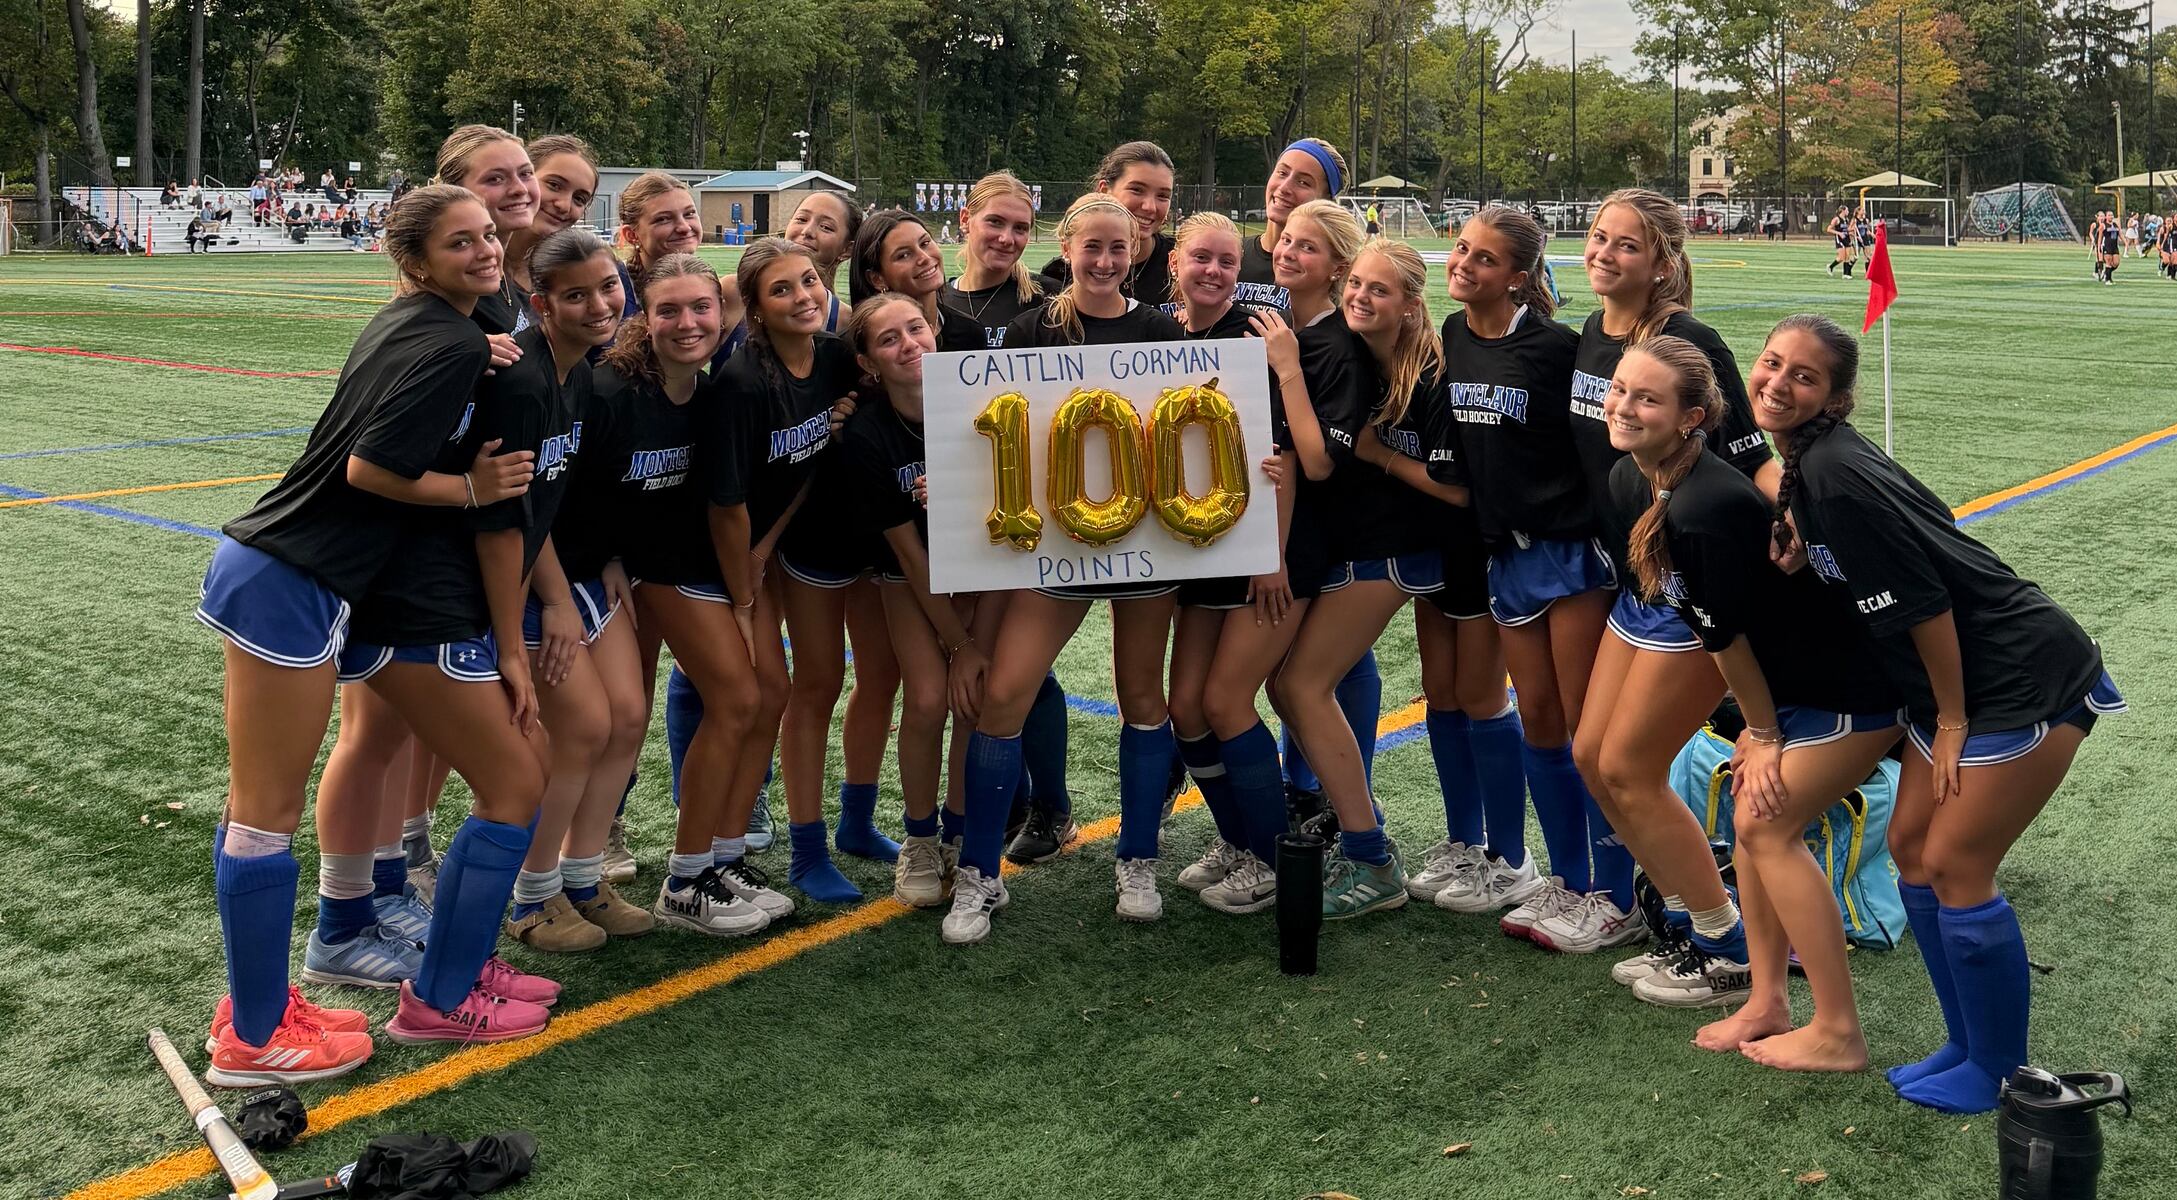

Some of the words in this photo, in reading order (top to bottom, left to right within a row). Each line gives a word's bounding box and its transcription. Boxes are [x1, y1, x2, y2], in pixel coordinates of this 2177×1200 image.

[958, 352, 1084, 386] CAITLIN
[1110, 346, 1221, 380] GORMAN
[1469, 411, 1502, 425] HOCKEY
[1728, 438, 1746, 455] WE
[1743, 431, 1765, 449] CAN.
[789, 449, 812, 464] FIELD
[973, 383, 1250, 553] 100
[642, 477, 668, 490] FIELD
[1039, 550, 1154, 585] POINTS
[1866, 590, 1897, 612] CAN.
[219, 1141, 259, 1180] ritual
